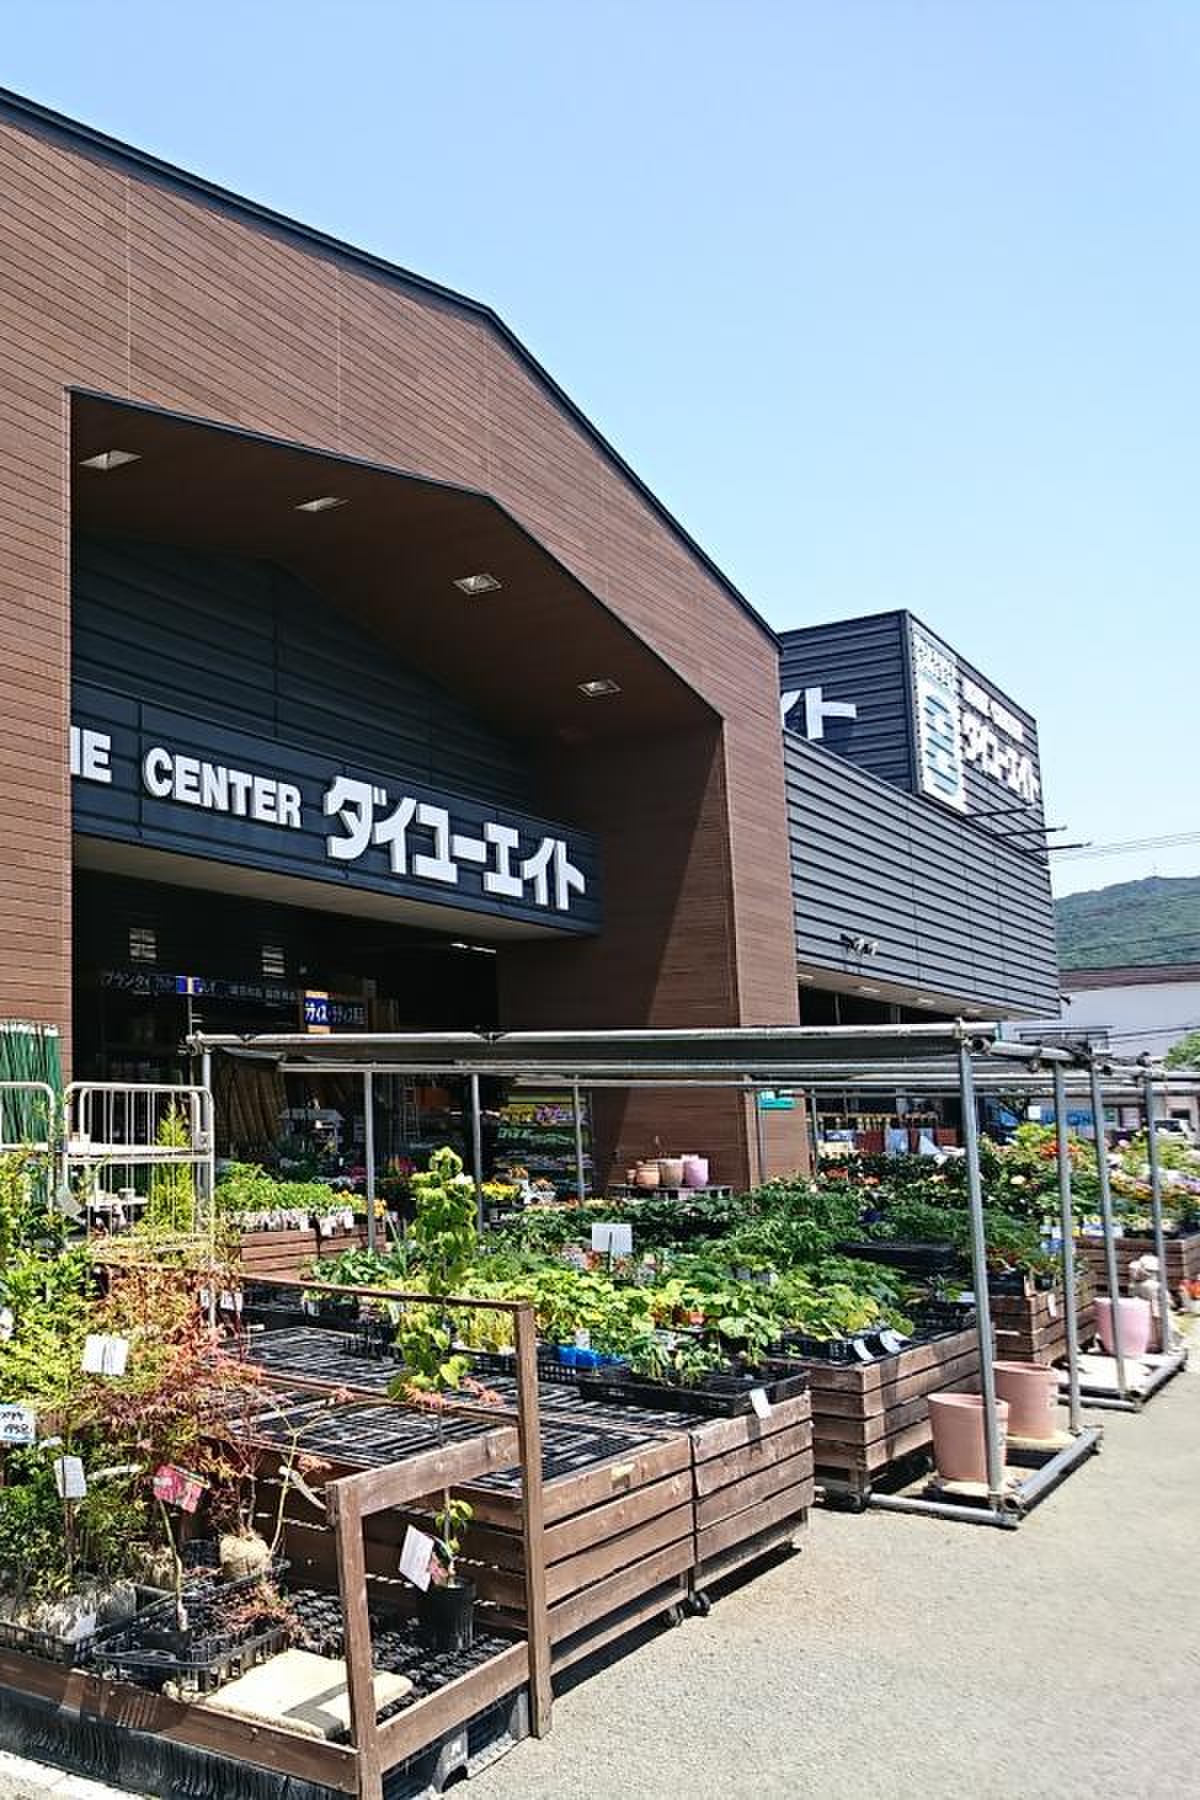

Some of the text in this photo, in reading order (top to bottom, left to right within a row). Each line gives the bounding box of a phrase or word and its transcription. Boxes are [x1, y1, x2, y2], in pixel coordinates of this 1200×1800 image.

[143, 747, 302, 829] CENTER
[323, 775, 586, 911] ダイユーエイト
